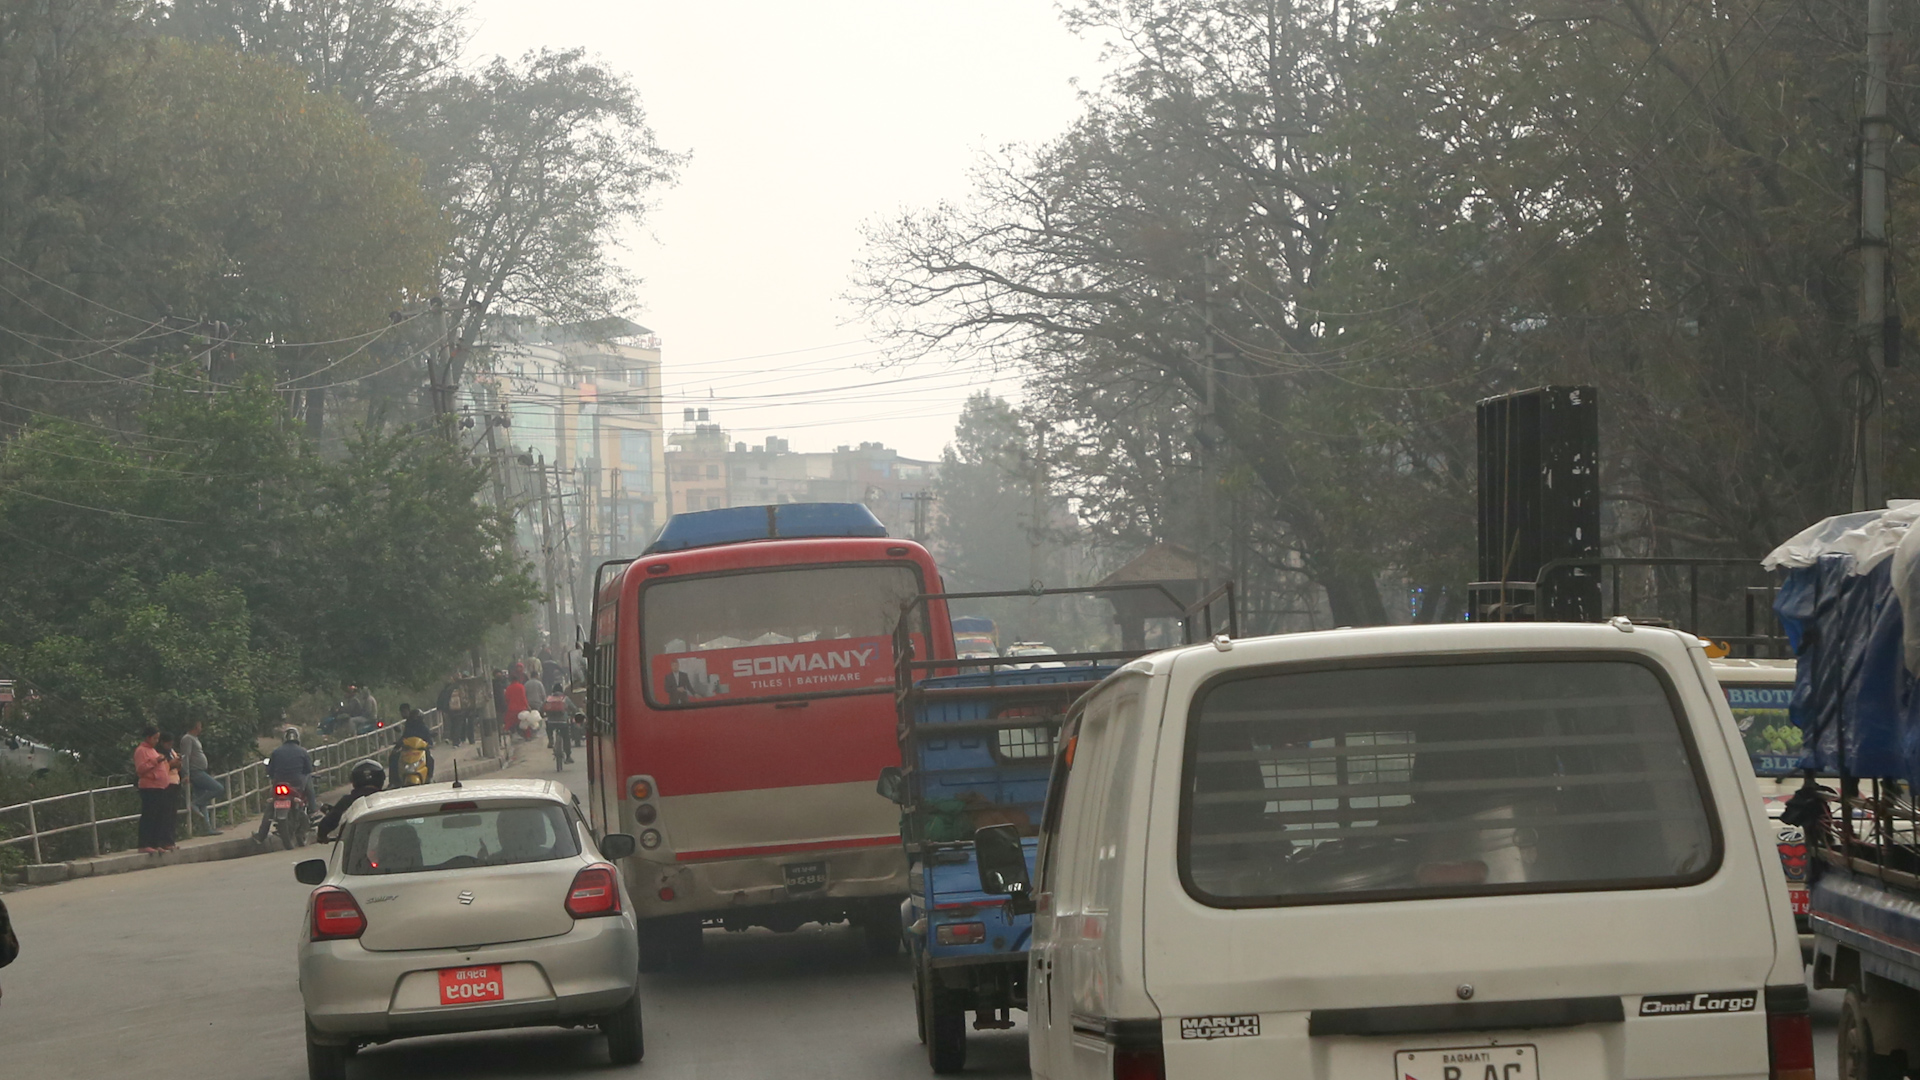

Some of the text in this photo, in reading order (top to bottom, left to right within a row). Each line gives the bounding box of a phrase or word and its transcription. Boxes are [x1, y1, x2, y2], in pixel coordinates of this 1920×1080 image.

[733, 648, 873, 677] SOMANY
[750, 678, 783, 689] TILES
[797, 672, 861, 685] BATHWARE
[1641, 994, 1754, 1013] Omni Cargo
[1182, 1016, 1258, 1028] MARUTI
[1183, 1026, 1259, 1038] SUZUKI
[1443, 1053, 1490, 1063] BAGMATI
